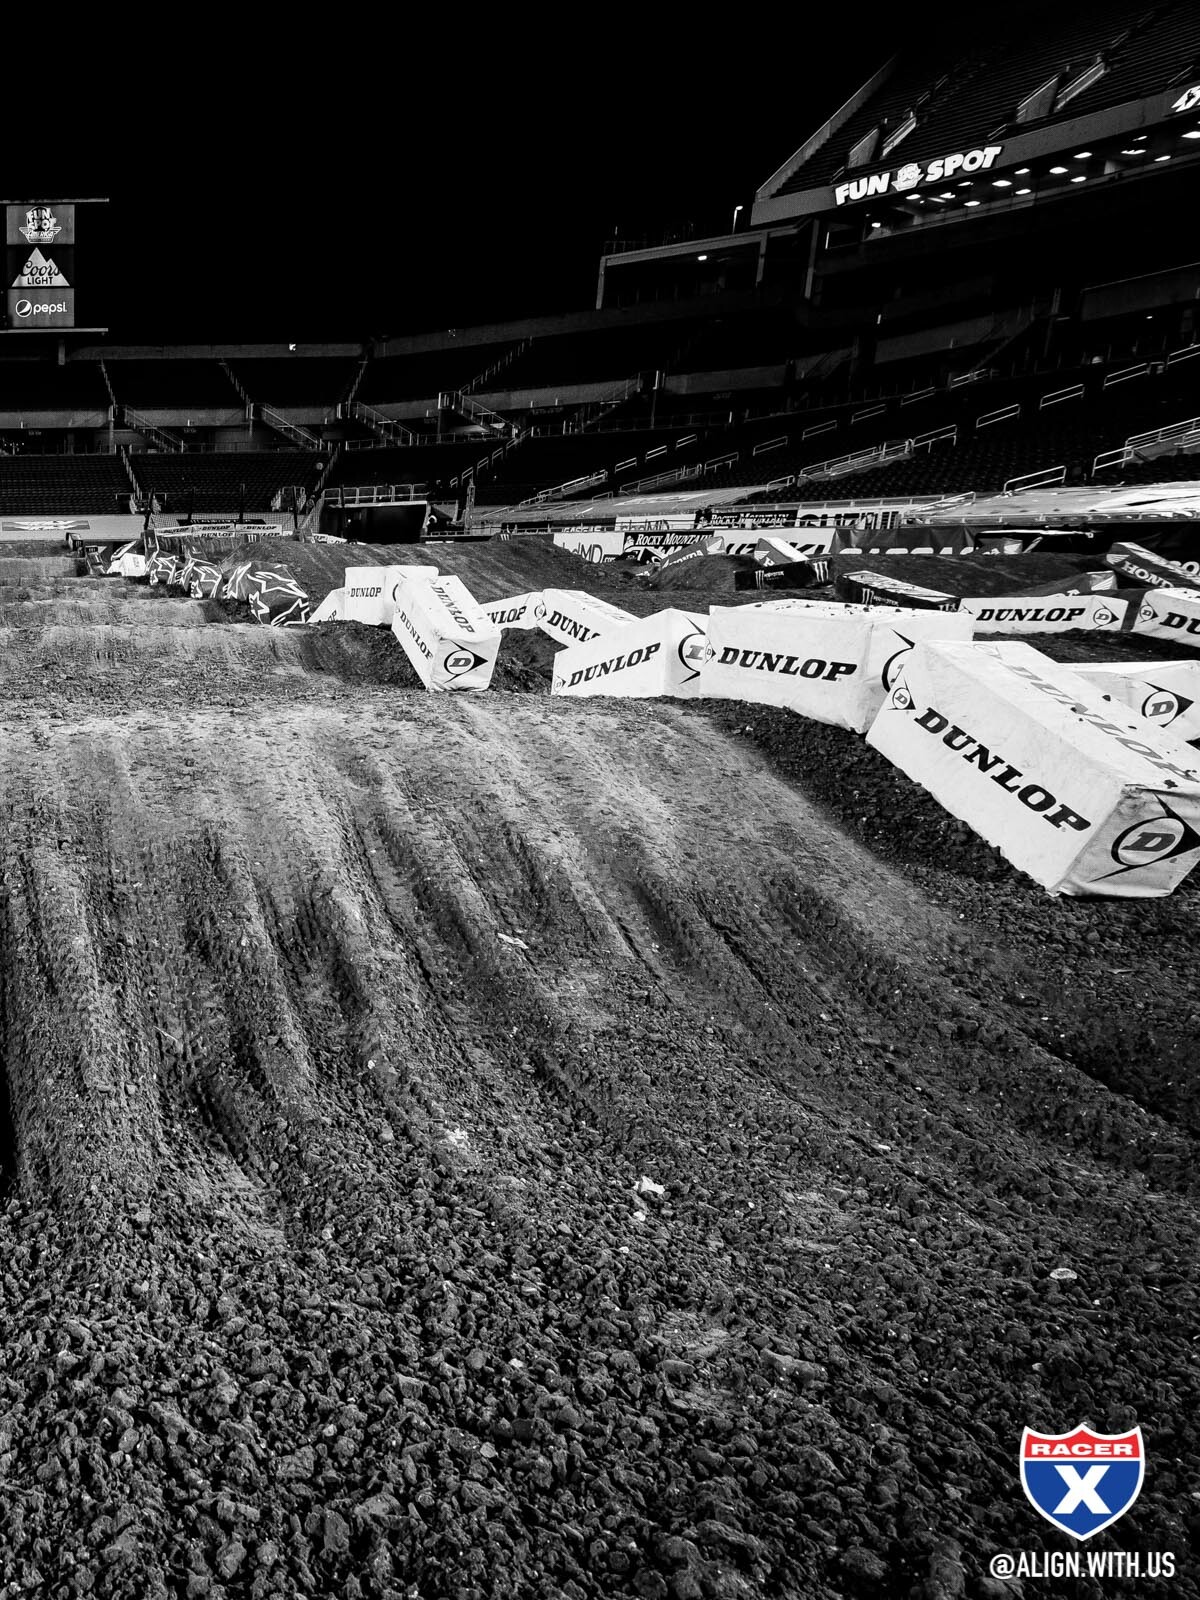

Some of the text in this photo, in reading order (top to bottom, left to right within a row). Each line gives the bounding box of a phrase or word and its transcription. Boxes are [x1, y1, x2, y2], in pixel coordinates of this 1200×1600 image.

[835, 147, 1002, 205] FUN SPOT
[25, 207, 52, 222] FUN
[22, 260, 59, 277] Coors
[27, 277, 53, 285] LIGHT
[33, 301, 66, 315] pepsi
[635, 534, 663, 545] ROCKY
[1122, 560, 1175, 588] HOND
[350, 587, 382, 597] DUNLOP
[432, 586, 475, 633] DUNLOP
[976, 608, 1085, 622] DUNLOP
[547, 610, 600, 643] DUNL
[568, 642, 661, 687] DUNLOP
[717, 647, 857, 683] DUNLOP
[913, 707, 1092, 831] DUNLOP
